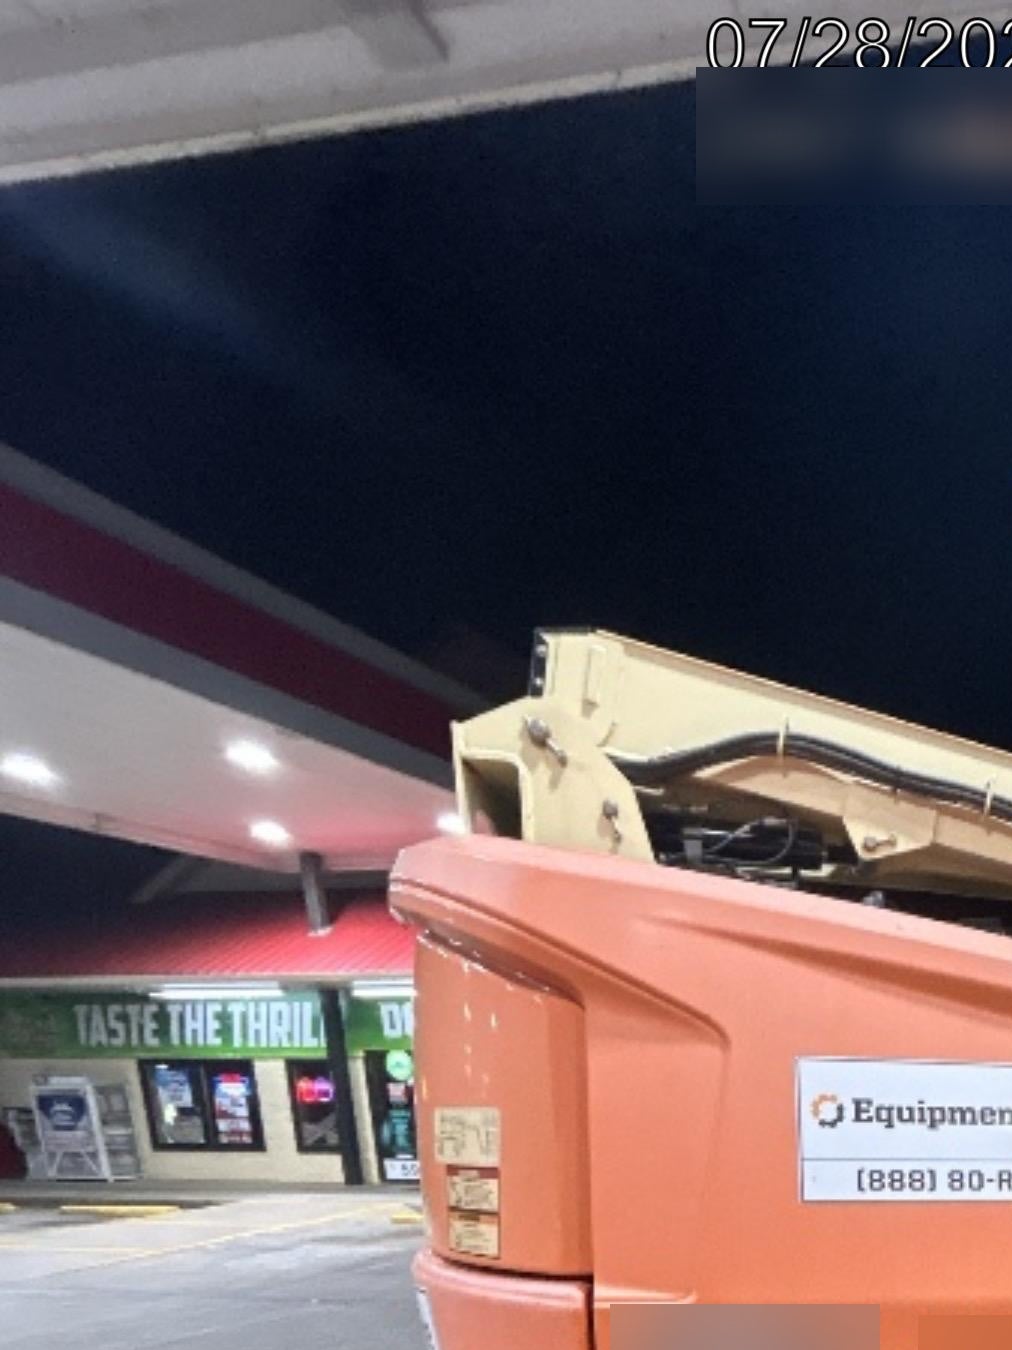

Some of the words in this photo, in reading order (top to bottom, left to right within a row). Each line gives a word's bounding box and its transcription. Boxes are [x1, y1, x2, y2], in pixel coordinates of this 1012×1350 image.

[74, 1004, 161, 1047] TASTE
[167, 1002, 222, 1046] THE
[227, 1001, 328, 1048] THRIL
